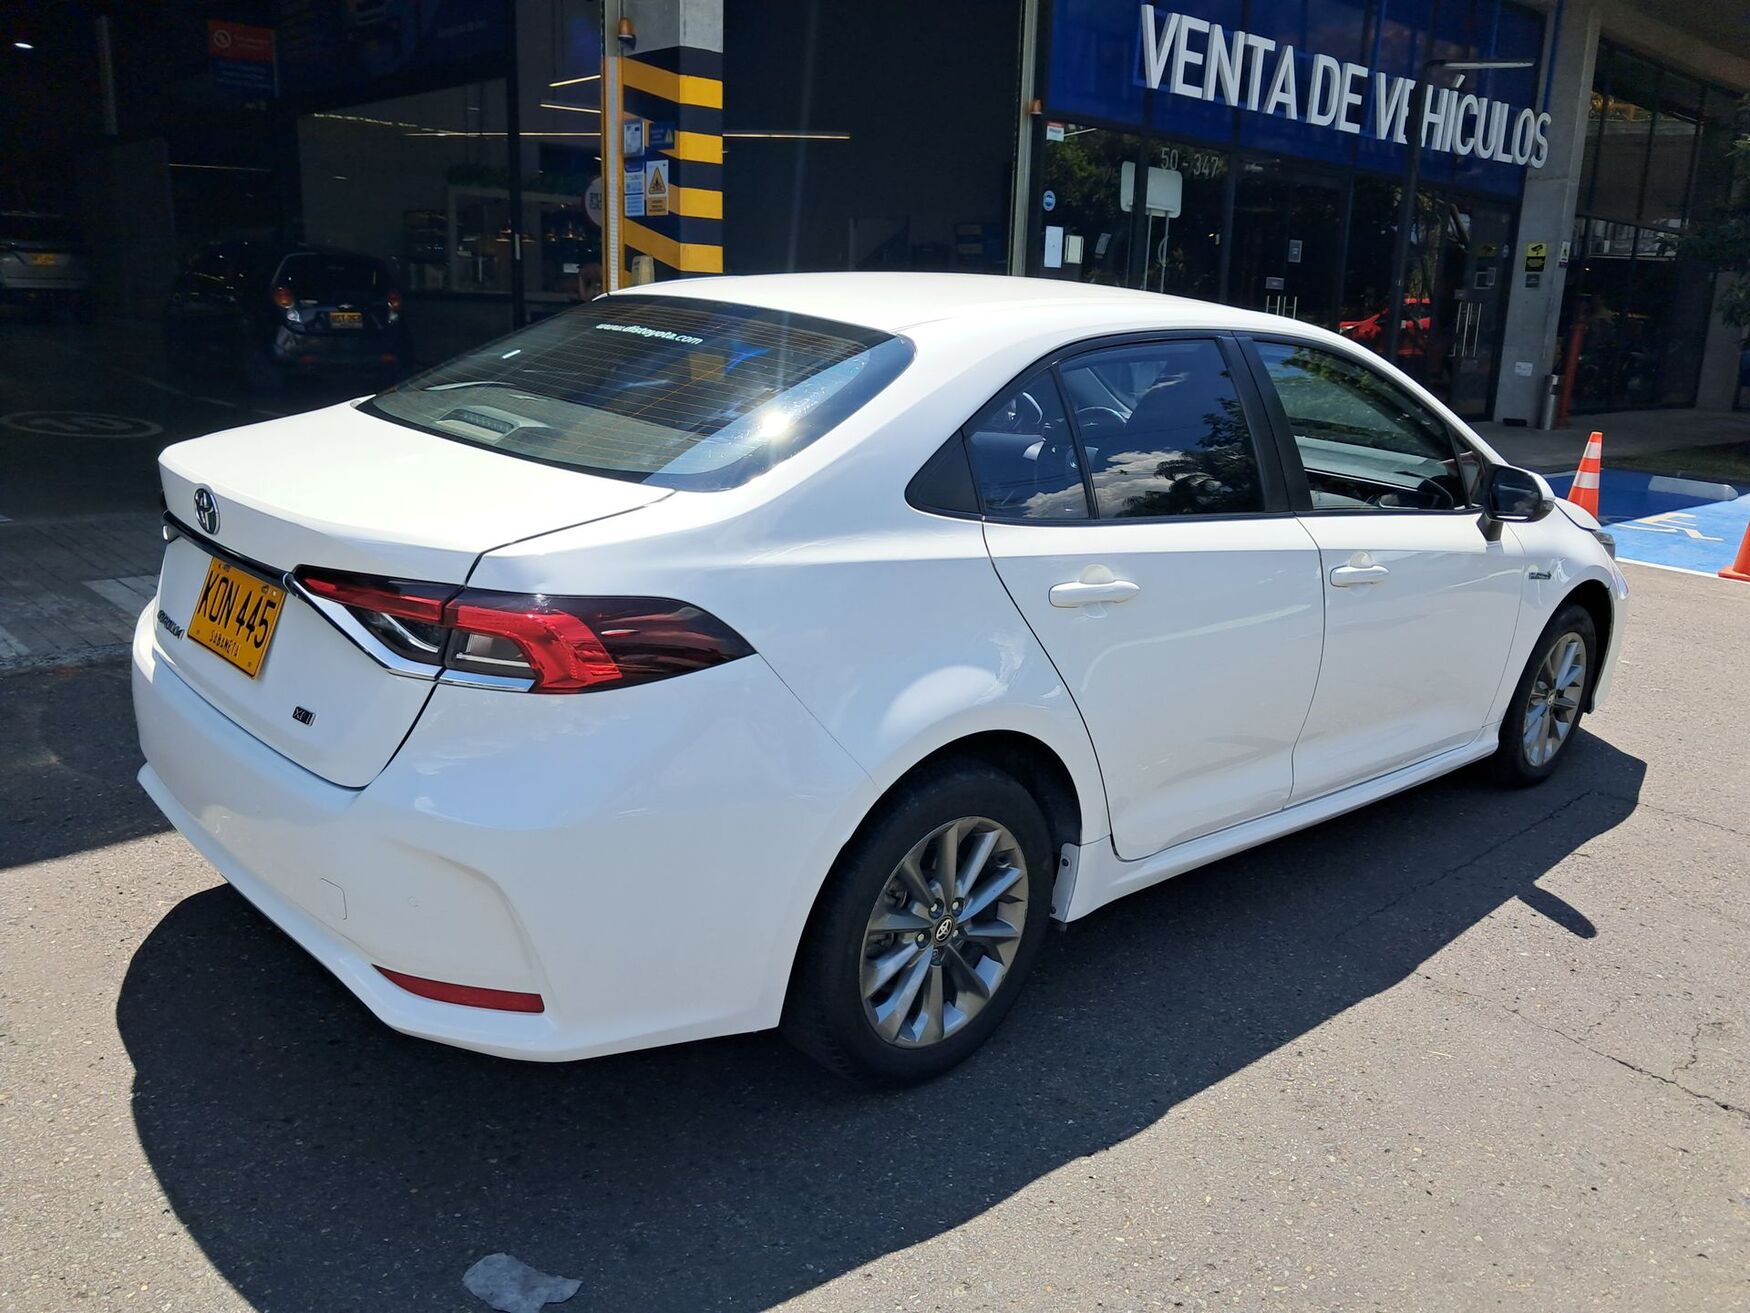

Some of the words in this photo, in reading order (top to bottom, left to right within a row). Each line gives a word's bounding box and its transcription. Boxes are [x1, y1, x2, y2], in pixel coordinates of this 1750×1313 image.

[1141, 4, 1298, 120] VENTA
[1306, 53, 1368, 134] DE
[1160, 147, 1179, 170] 50
[1193, 153, 1219, 177] 347
[595, 323, 704, 345] www.distoyota.com
[197, 570, 241, 629] KON
[236, 591, 276, 649] 445
